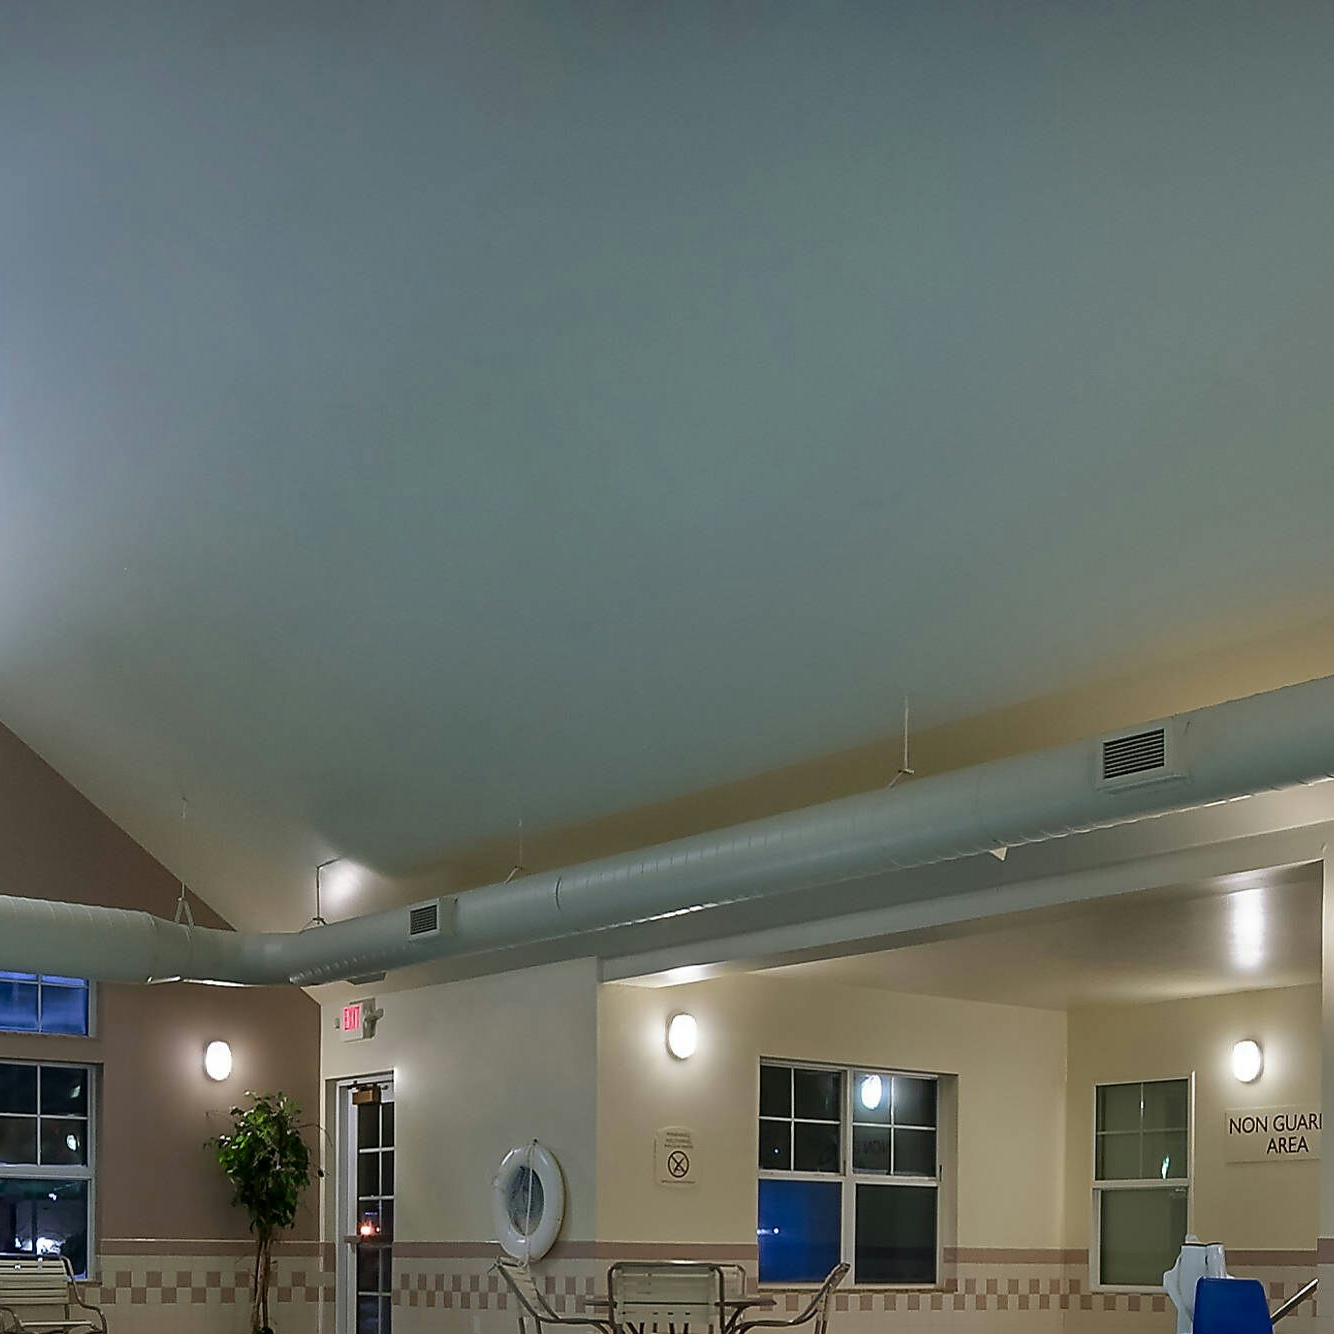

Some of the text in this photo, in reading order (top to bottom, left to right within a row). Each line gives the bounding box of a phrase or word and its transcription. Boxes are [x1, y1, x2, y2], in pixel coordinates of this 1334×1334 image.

[343, 1005, 360, 1031] EXIT
[1229, 1113, 1322, 1134] NON GUAR
[1266, 1136, 1309, 1154] AREA
